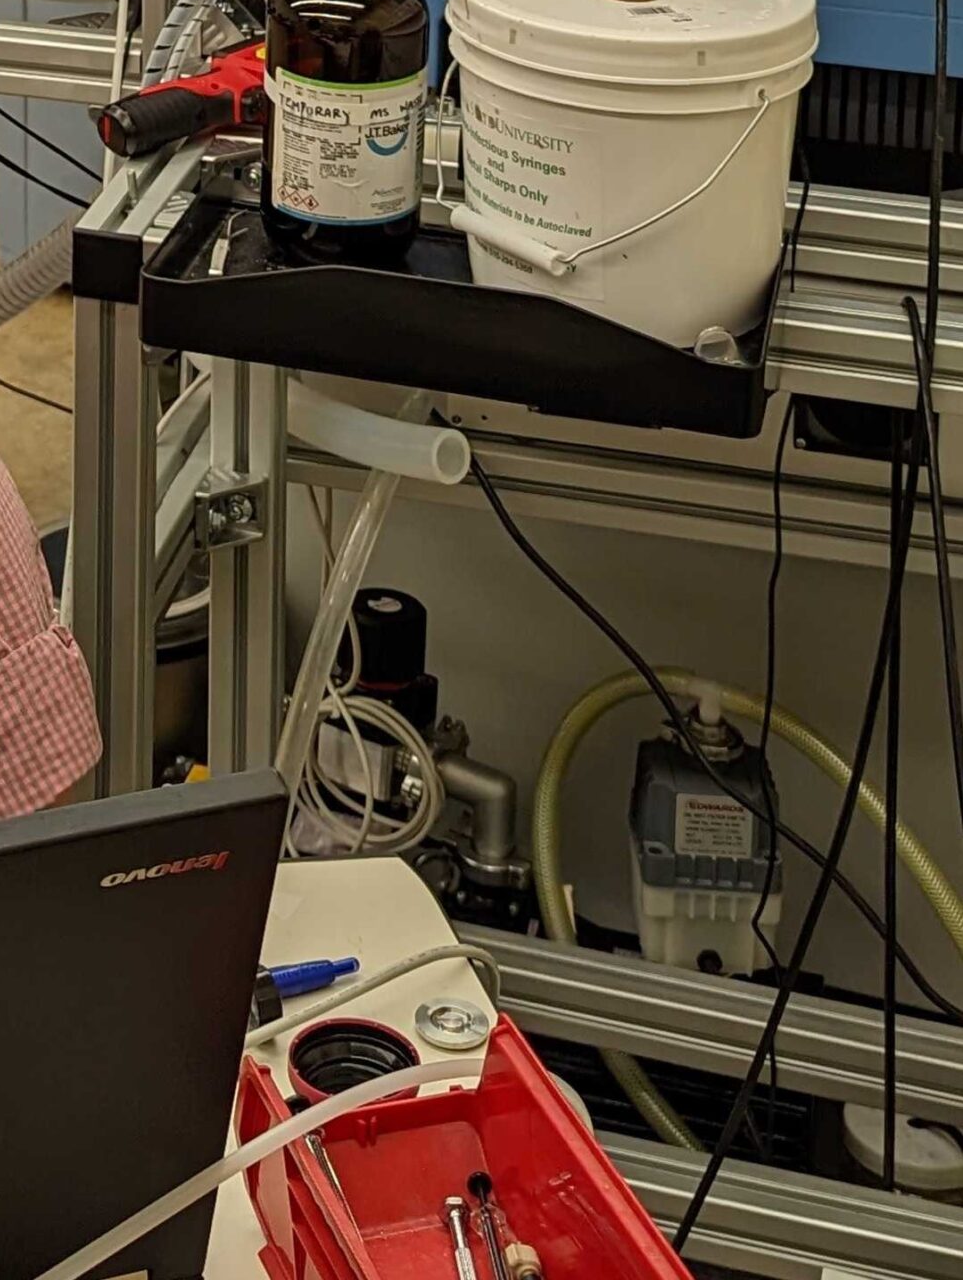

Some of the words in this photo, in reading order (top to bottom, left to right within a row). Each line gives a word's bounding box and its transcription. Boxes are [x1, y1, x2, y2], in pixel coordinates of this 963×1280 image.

[279, 93, 350, 127] TEMPORARY
[370, 107, 390, 120] MS
[495, 117, 574, 154] UNIVERSITY
[487, 157, 505, 174] and
[511, 150, 567, 177] Syringes
[483, 167, 516, 193] Sharps
[519, 184, 549, 206] Only
[514, 210, 523, 222] to
[523, 213, 536, 226] be
[536, 217, 593, 238] Autoclaved
[99, 850, 230, 888] lenovo
